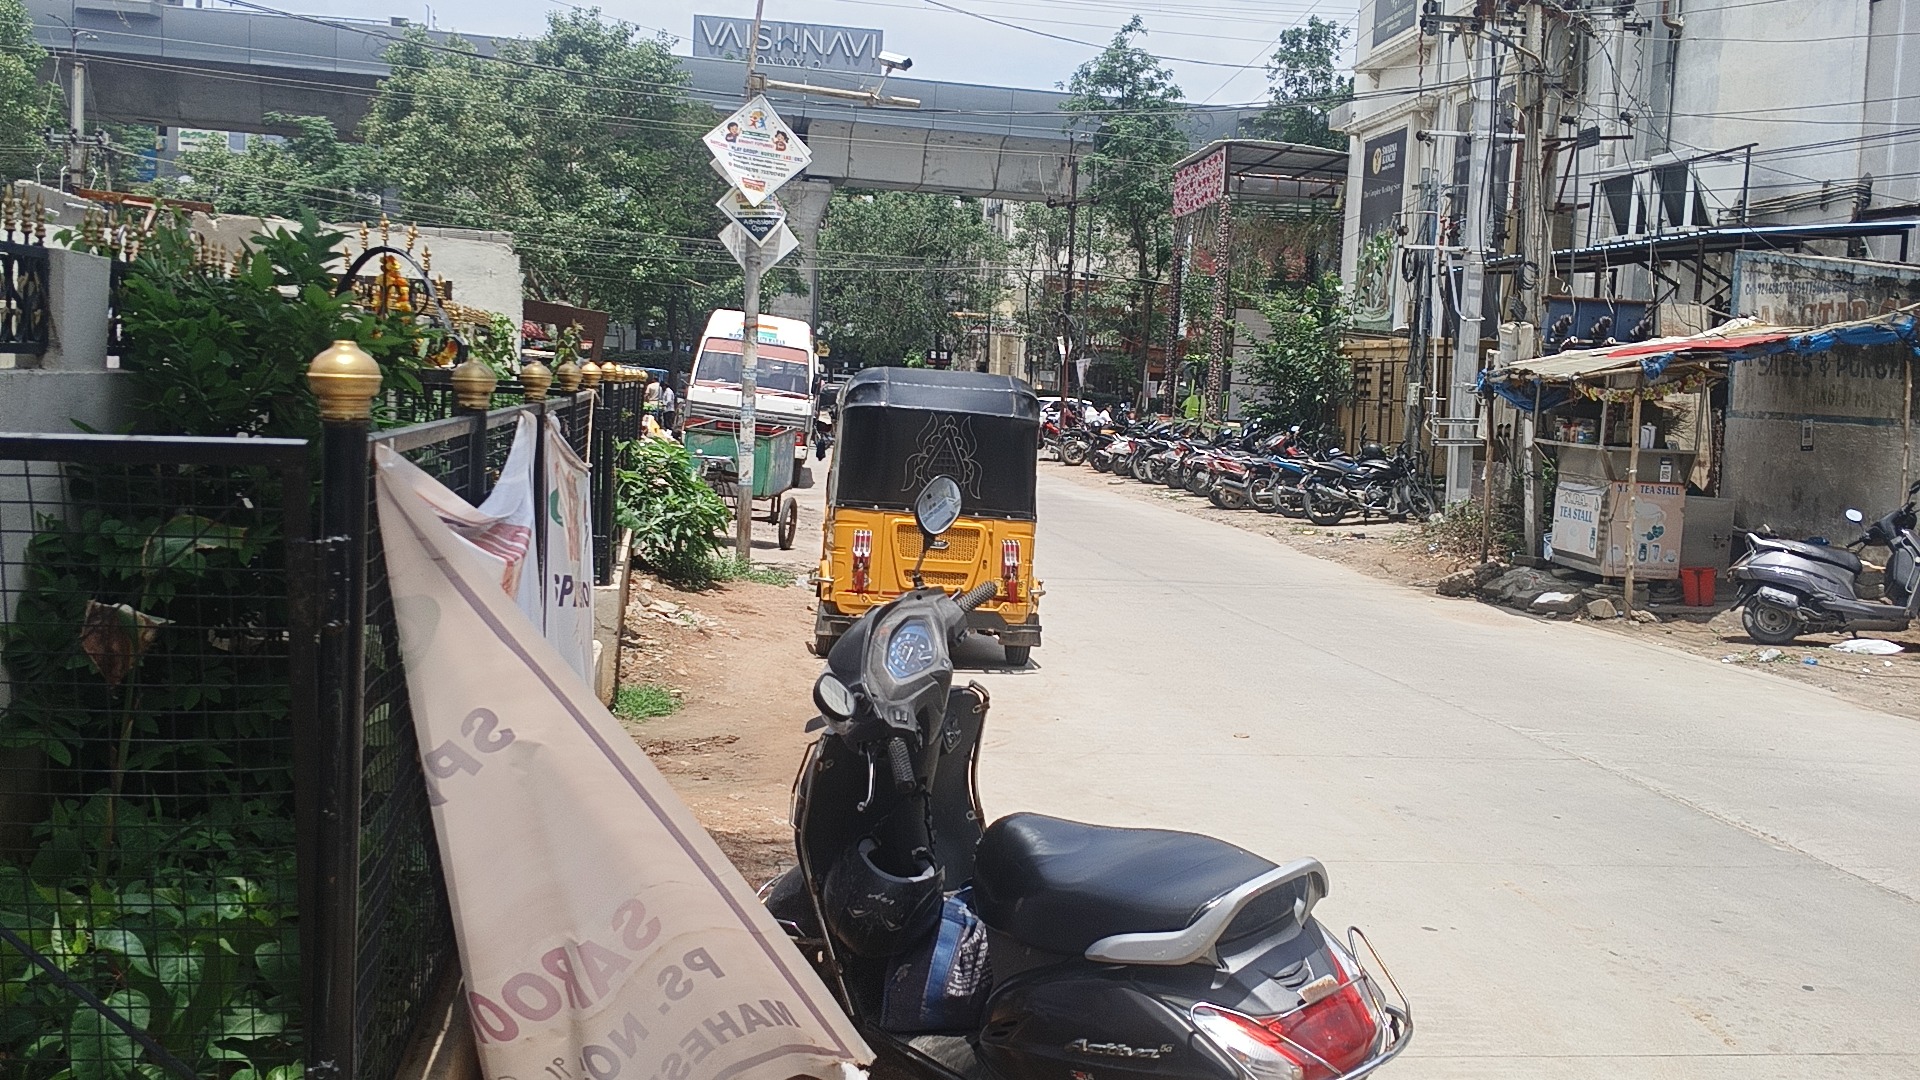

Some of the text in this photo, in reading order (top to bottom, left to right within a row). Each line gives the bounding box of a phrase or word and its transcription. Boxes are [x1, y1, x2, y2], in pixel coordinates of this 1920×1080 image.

[700, 20, 877, 59] VAISHNAVI
[1640, 485, 1656, 494] TEA
[1656, 485, 1680, 496] STALL
[1560, 505, 1593, 523] TEA STALL
